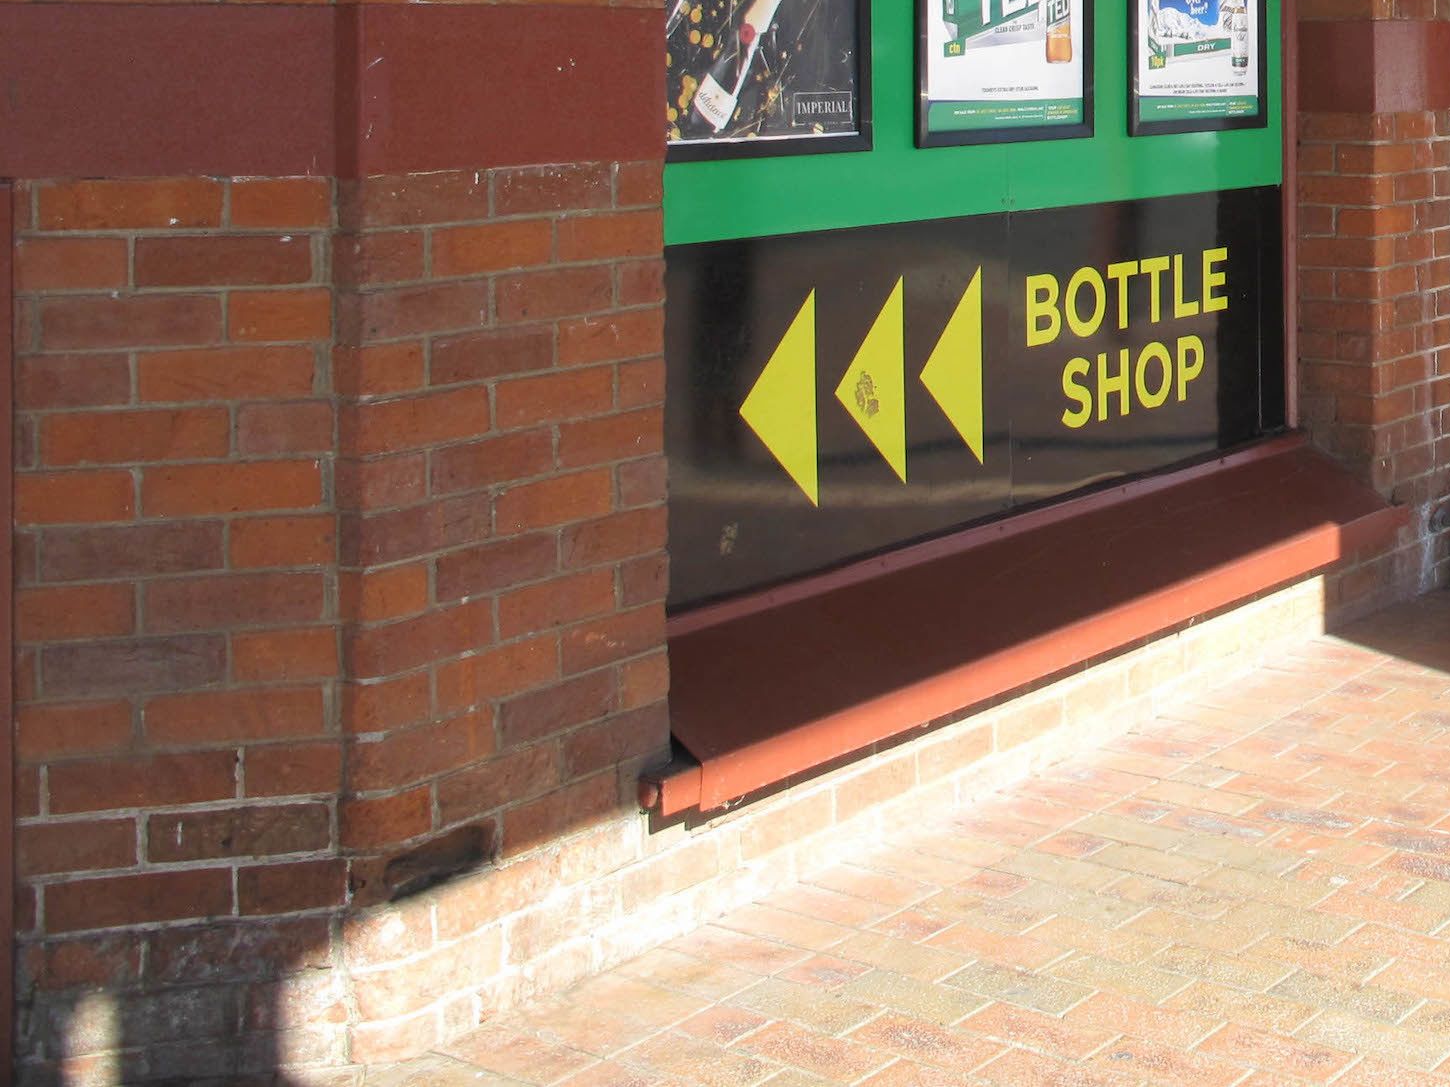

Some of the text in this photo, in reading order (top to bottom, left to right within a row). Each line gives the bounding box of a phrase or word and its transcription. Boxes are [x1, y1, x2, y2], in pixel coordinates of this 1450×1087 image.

[1197, 42, 1216, 52] DRY
[797, 100, 849, 115] IMPERIAL
[1026, 247, 1229, 348] BOTTLE
[1061, 334, 1205, 430] SHOP
